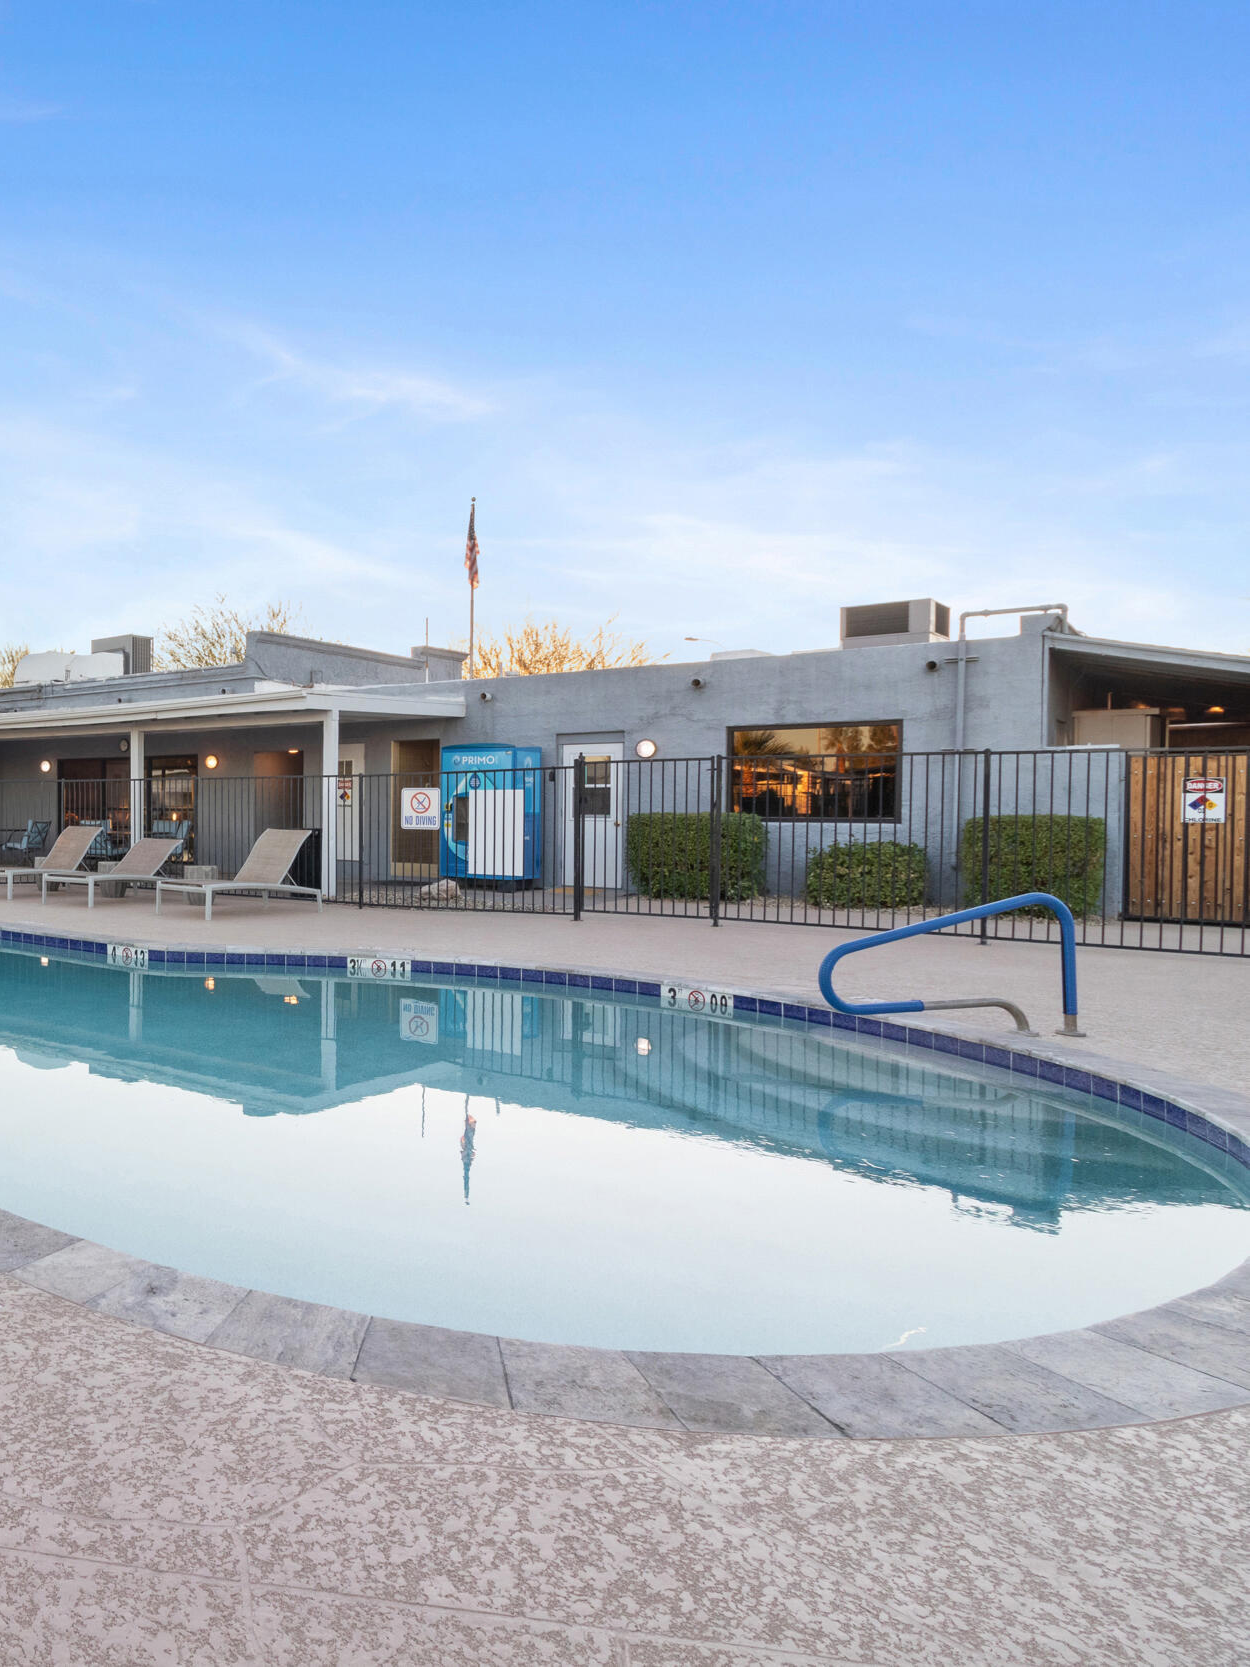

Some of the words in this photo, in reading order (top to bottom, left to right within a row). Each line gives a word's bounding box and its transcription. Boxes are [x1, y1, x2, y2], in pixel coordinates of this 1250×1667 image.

[461, 755, 495, 765] PRIMO
[404, 815, 413, 825] NO
[415, 815, 437, 826] DIVING
